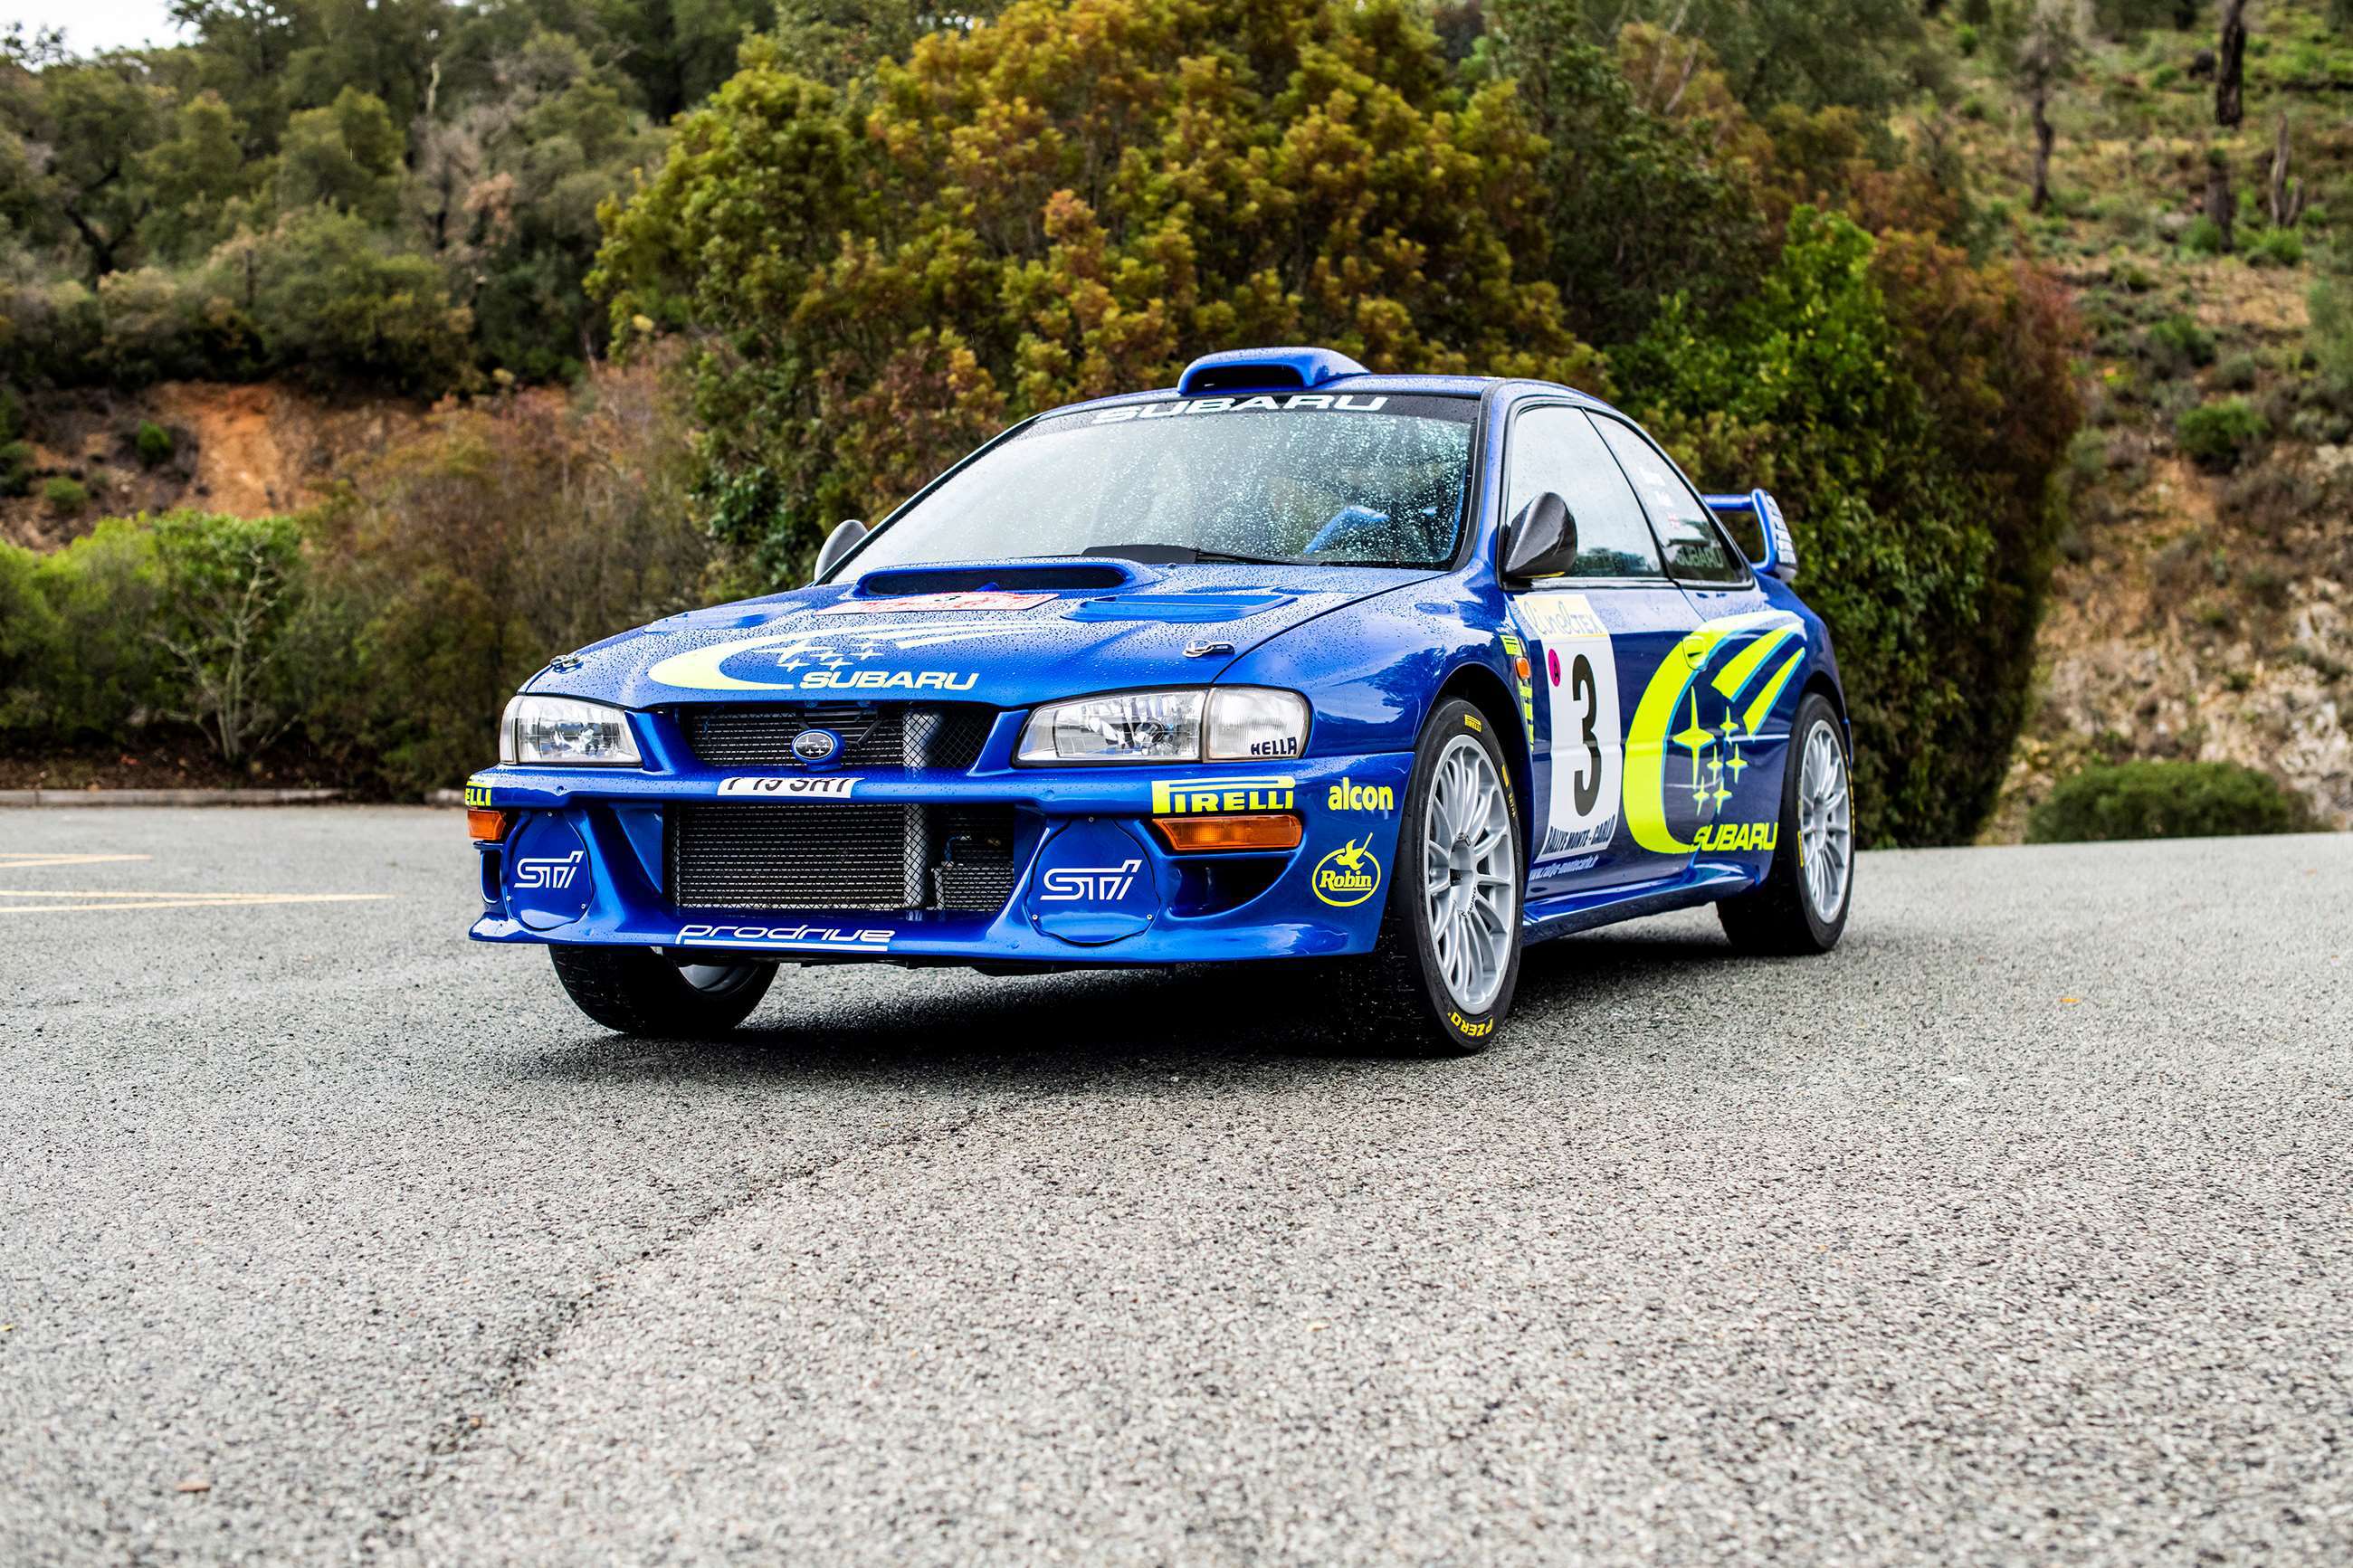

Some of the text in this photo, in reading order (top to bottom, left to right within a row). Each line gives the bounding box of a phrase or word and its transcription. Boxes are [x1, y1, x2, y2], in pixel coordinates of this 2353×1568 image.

[1092, 394, 1388, 423] SUBARU
[800, 670, 980, 690] SUBARU
[1251, 736, 1297, 755] HELLA
[1571, 653, 1603, 817] 3
[1151, 775, 1296, 814] PIRELLI
[1328, 776, 1394, 811] alcon
[1690, 821, 1778, 853] SUBARU
[1319, 870, 1372, 889] Robin
